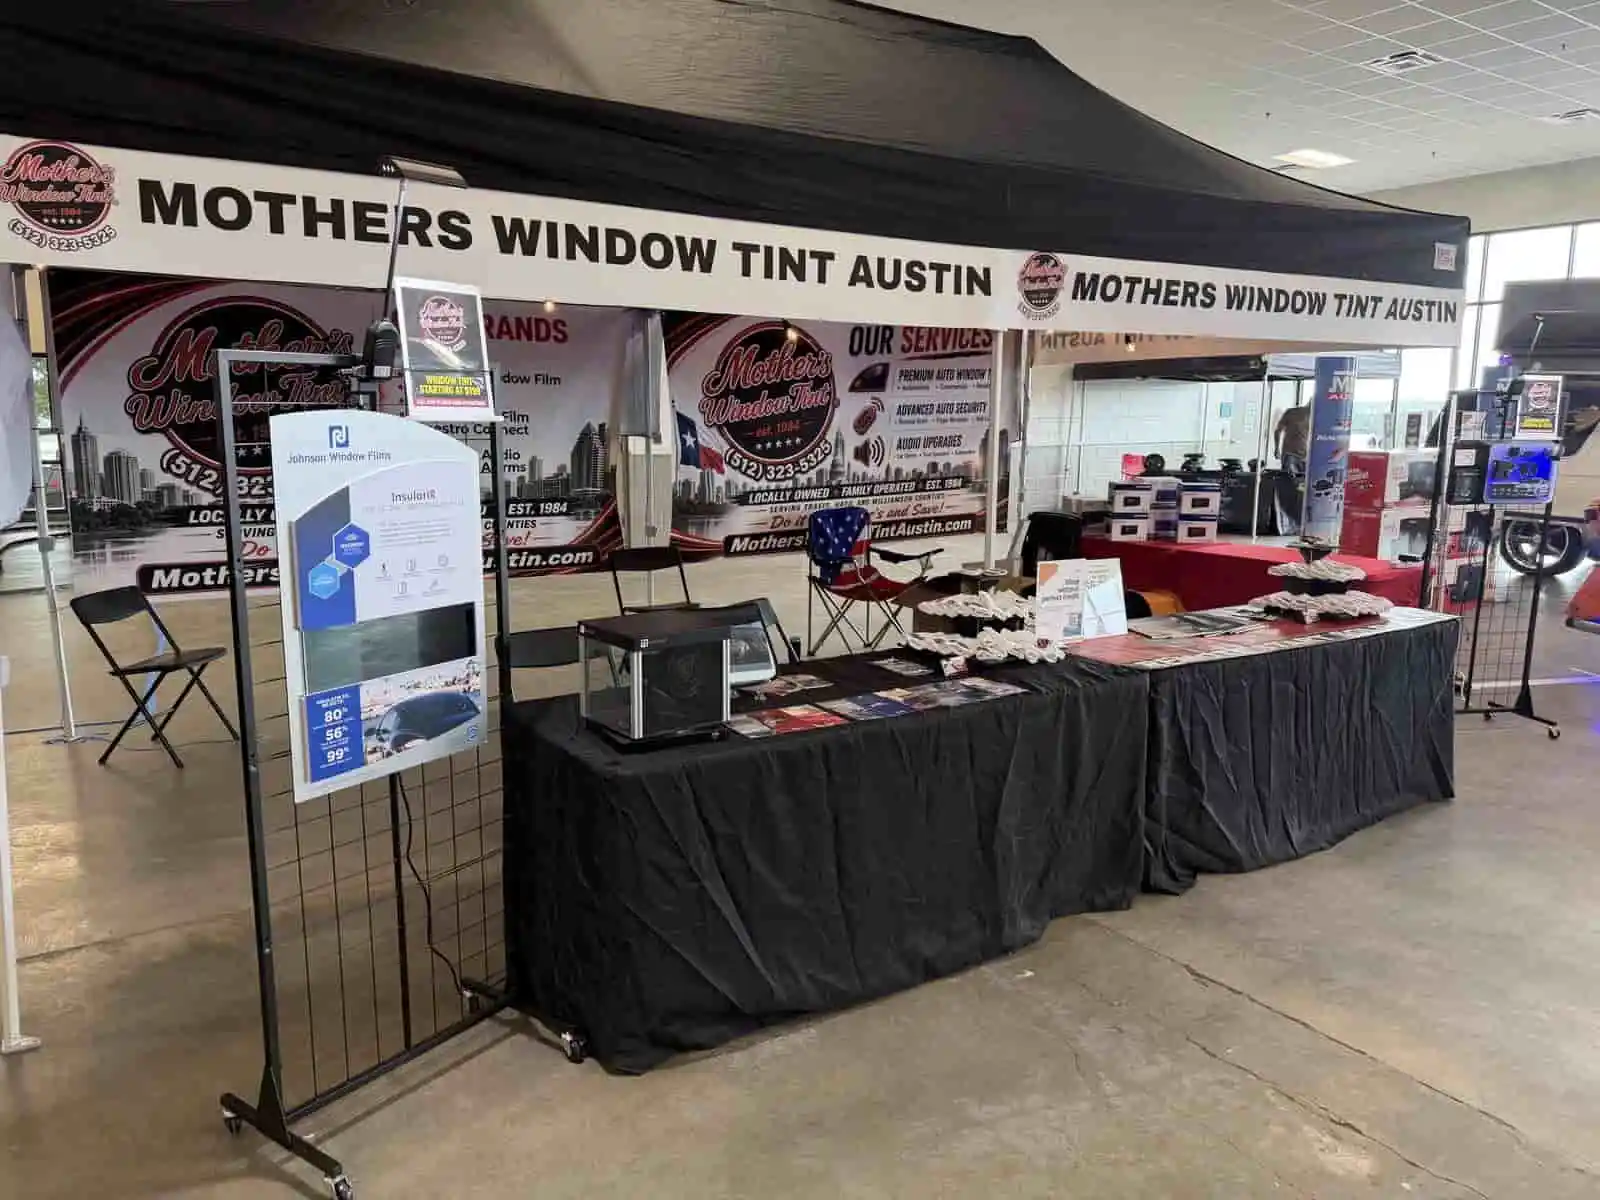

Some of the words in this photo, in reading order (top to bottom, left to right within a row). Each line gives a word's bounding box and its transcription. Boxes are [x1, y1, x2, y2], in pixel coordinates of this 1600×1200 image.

[8, 218, 47, 249] (512)
[48, 224, 117, 252] 323-5325
[138, 178, 473, 250] MOTHERS
[491, 215, 717, 273] WINDOW
[732, 242, 835, 284] TINT
[847, 255, 993, 297] AUSTIN
[1071, 272, 1217, 309] MOTHERS
[1225, 284, 1328, 316] WINDOW
[1333, 294, 1383, 320] TINT
[1384, 297, 1457, 324] AUSTIN
[849, 326, 894, 356] OUR
[901, 326, 993, 354] SERVICES
[534, 373, 561, 386] Film
[702, 344, 833, 396] Mother's
[699, 391, 792, 428] Window
[789, 381, 832, 413] Tint
[287, 452, 327, 464] Johnson
[328, 451, 365, 463] Window
[367, 450, 392, 461] Films
[725, 447, 764, 481] (512)
[765, 439, 833, 481] 323-5325
[748, 490, 792, 504] LOCALLY
[794, 487, 830, 500] OWNED
[841, 483, 873, 497] FAMILY
[873, 480, 916, 494] OPERATED
[508, 503, 535, 515] EST.
[540, 502, 568, 513] 1984
[241, 540, 271, 556] Do
